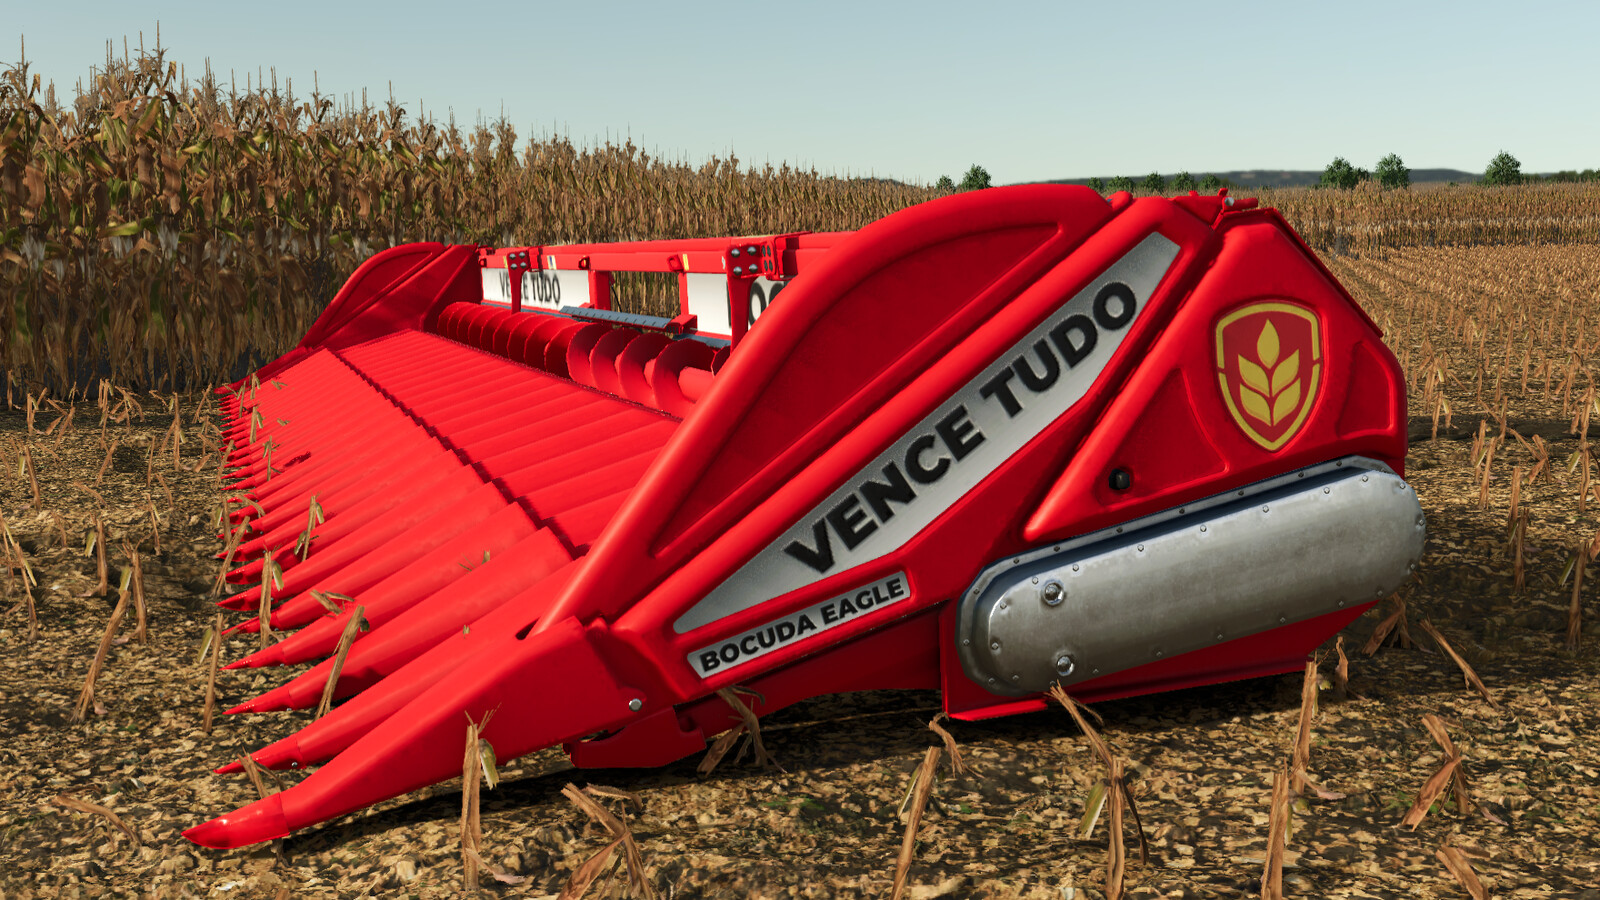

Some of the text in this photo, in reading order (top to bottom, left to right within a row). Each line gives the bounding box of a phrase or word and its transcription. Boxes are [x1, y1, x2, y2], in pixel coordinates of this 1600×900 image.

[499, 271, 561, 304] VEE TUDO
[784, 281, 1137, 574] VENCE TUDO
[699, 577, 904, 671] BOCUDA EAGLE
